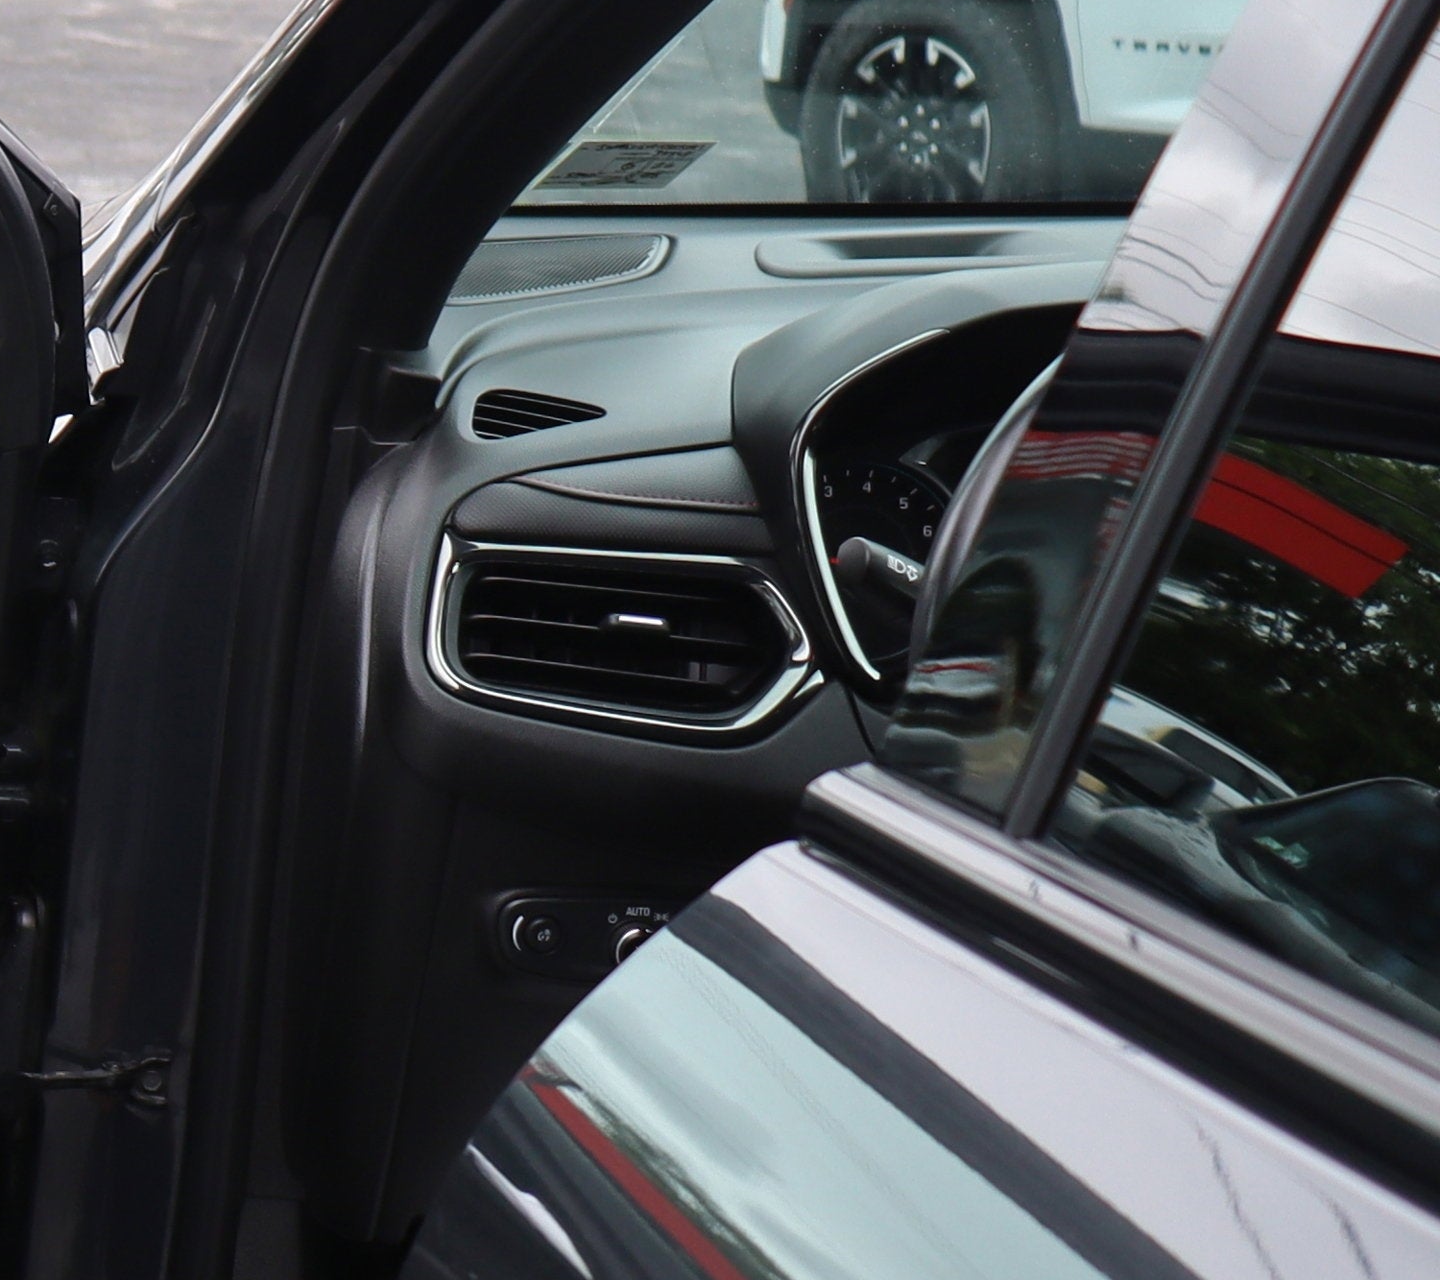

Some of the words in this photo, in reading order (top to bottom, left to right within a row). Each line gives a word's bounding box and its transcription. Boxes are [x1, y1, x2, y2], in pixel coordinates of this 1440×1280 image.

[823, 485, 833, 498] 3
[862, 480, 872, 493] 4
[899, 497, 909, 510] 5
[922, 525, 933, 538] 6
[625, 906, 651, 917] AUTO
